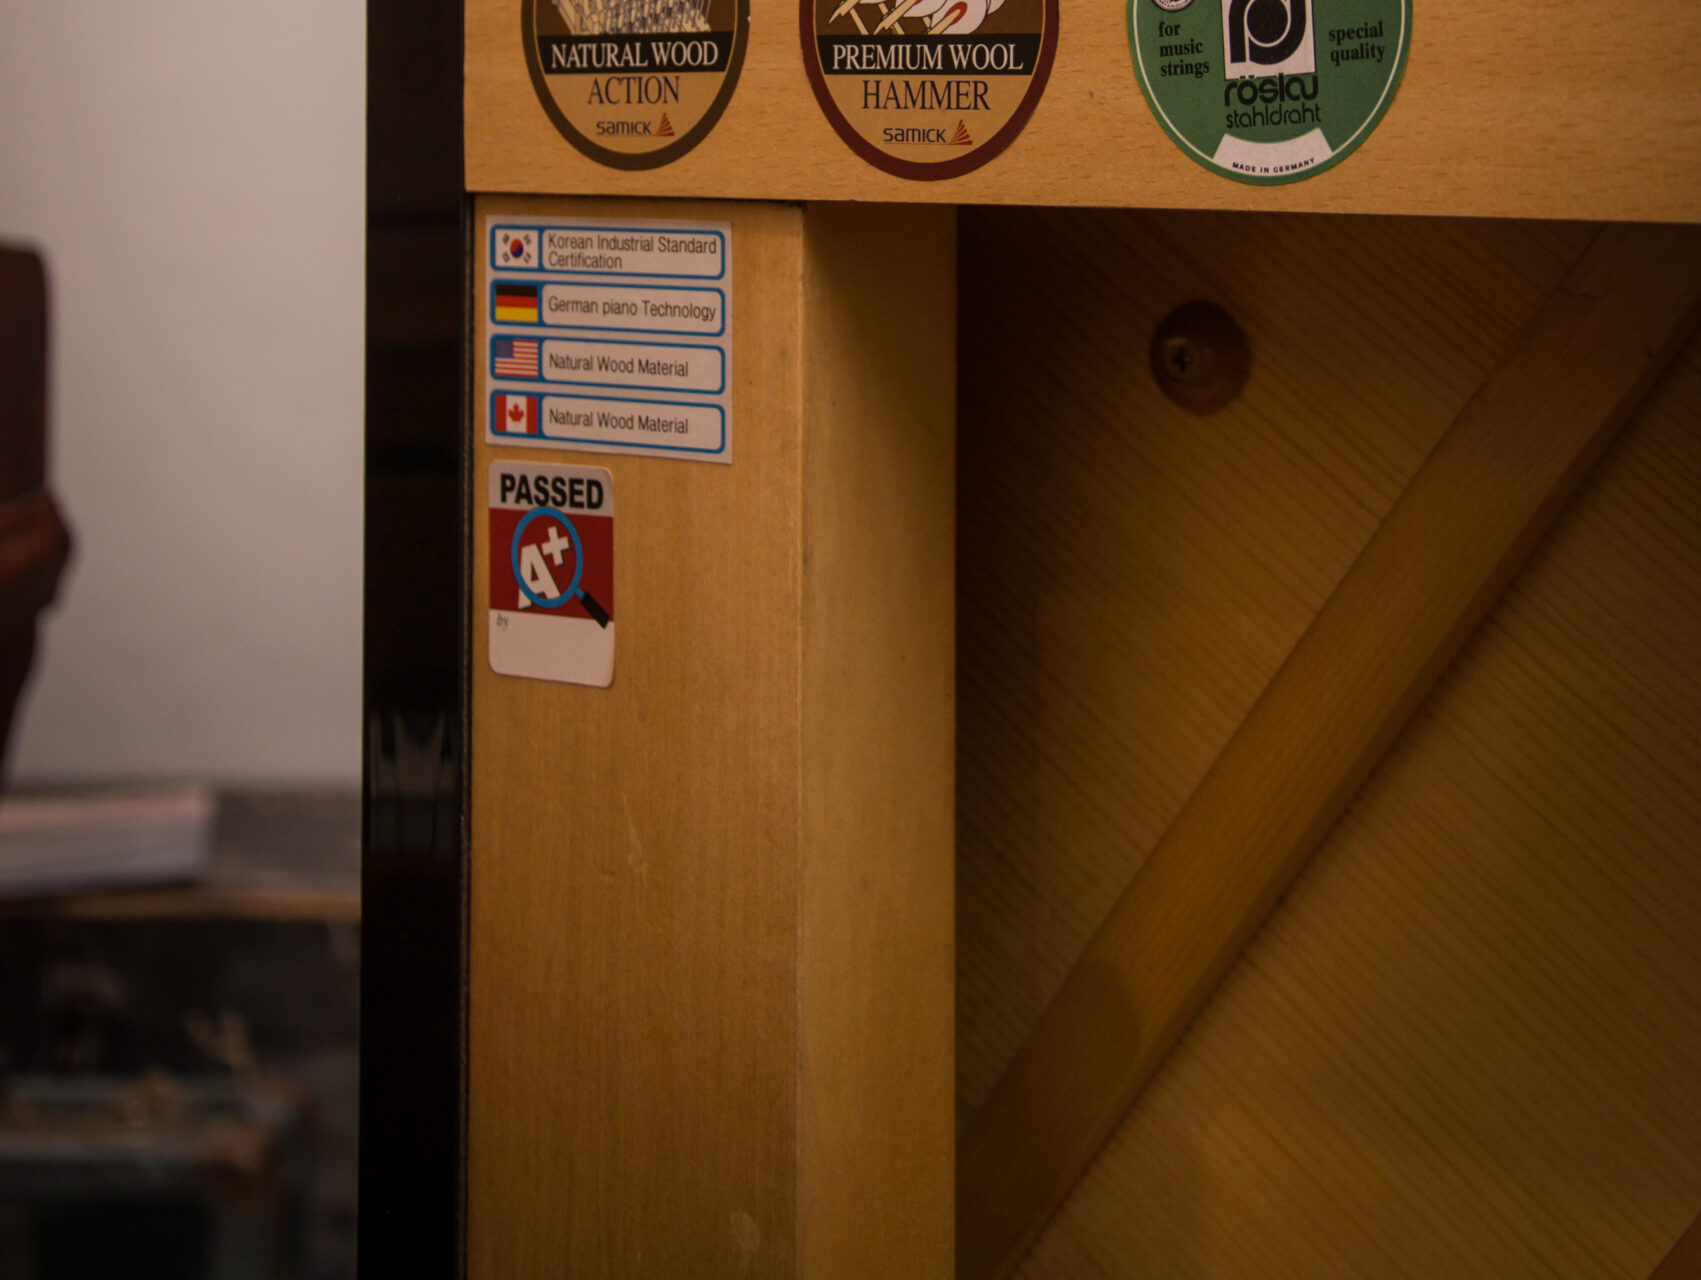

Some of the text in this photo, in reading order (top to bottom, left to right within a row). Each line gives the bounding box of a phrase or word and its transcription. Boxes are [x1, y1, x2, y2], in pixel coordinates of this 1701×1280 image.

[1158, 21, 1181, 37] for
[1328, 21, 1384, 43] special
[551, 40, 718, 68] NATURAL WOOD
[832, 43, 1024, 71] PREMIUM WOOL
[1160, 42, 1204, 58] music
[1330, 44, 1385, 66] quality
[1160, 60, 1210, 79] strings
[587, 76, 680, 105] ACTION
[862, 79, 991, 111] HAMMER
[1226, 102, 1321, 129] stahldraht
[1232, 161, 1256, 173] MADE
[1273, 157, 1314, 173] GERMANY
[548, 234, 717, 254] Korean Industrial Standard
[548, 251, 622, 269] Certification
[548, 296, 716, 321] German piano Technology
[549, 353, 688, 377] Natural Wood Material
[549, 409, 688, 434] Natural Wood Material
[500, 473, 604, 510] PASSED
